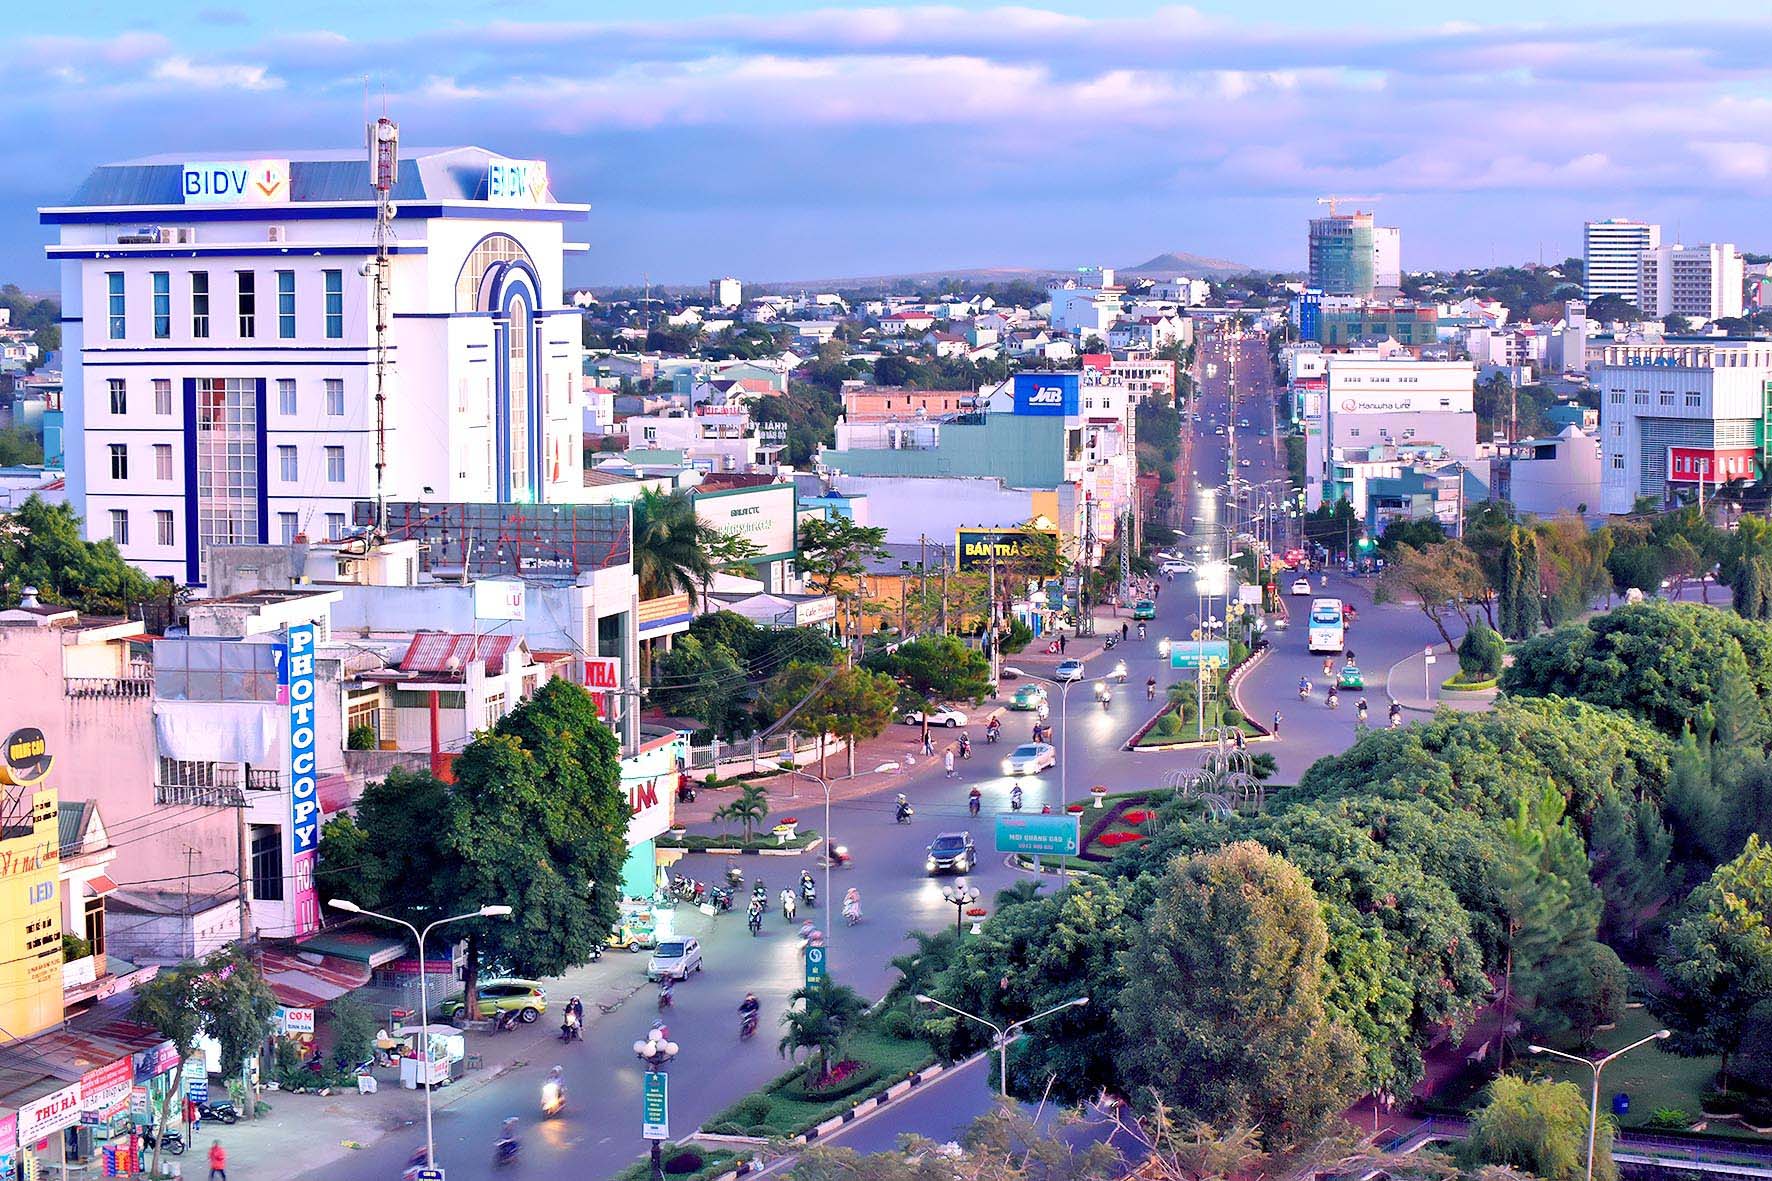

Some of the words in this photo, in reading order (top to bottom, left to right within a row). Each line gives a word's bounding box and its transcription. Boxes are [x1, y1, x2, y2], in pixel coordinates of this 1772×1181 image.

[185, 168, 247, 195] BIDV
[1358, 401, 1393, 410] Hanwha
[965, 541, 991, 556] BÁN
[994, 540, 1020, 556] TRẢ
[585, 661, 617, 688] NHA
[290, 631, 315, 848] PHOTOCOPY
[29, 881, 54, 905] LED
[36, 1101, 59, 1121] THU
[61, 1091, 77, 1112] HÀ
